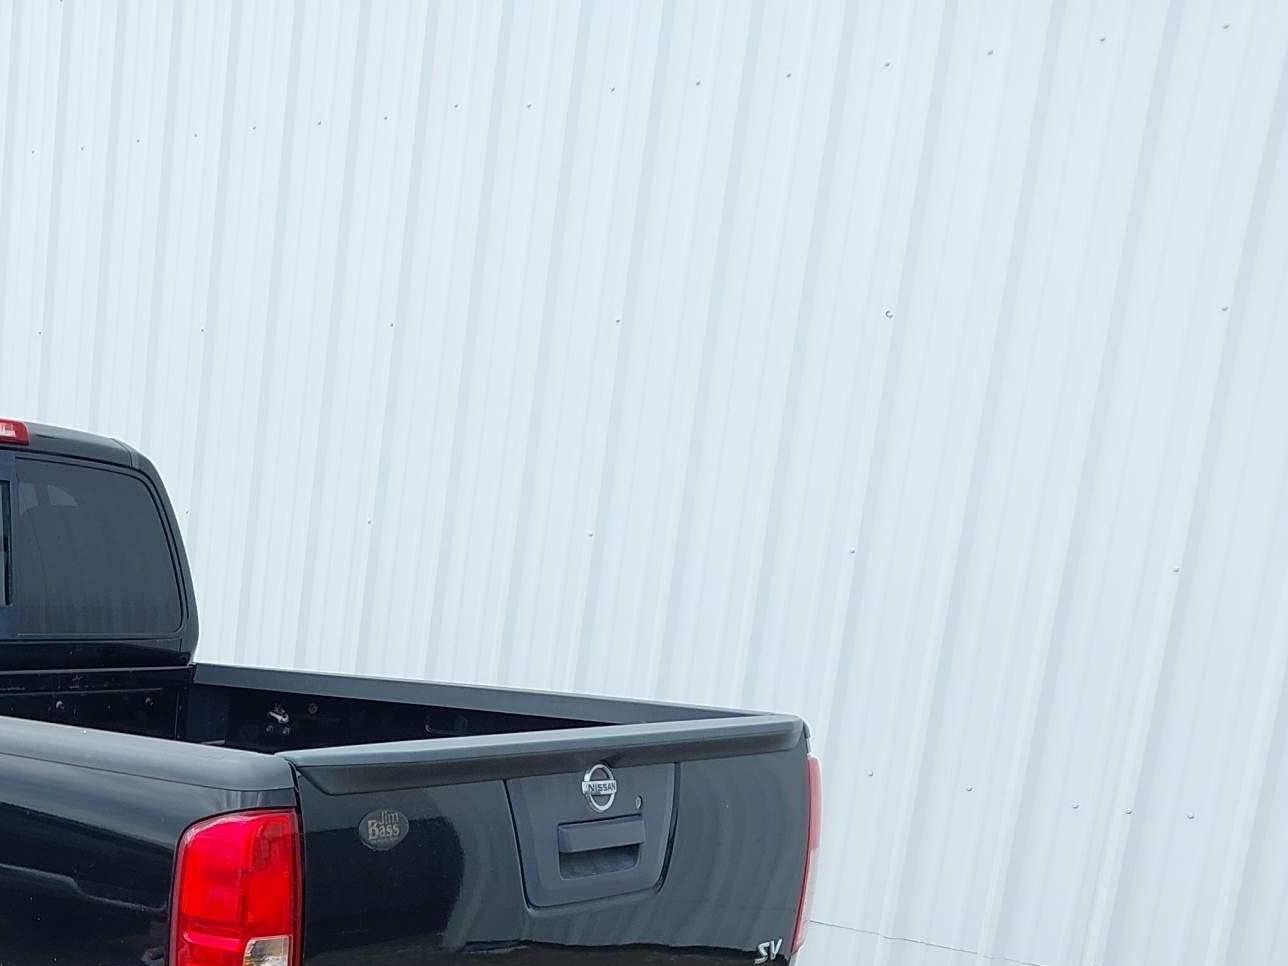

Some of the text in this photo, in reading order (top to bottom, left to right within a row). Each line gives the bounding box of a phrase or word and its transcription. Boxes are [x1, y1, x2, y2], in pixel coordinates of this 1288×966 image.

[587, 782, 616, 793] NISSAN
[379, 810, 399, 825] Jim
[368, 819, 400, 840] Bass
[754, 938, 783, 965] SV
